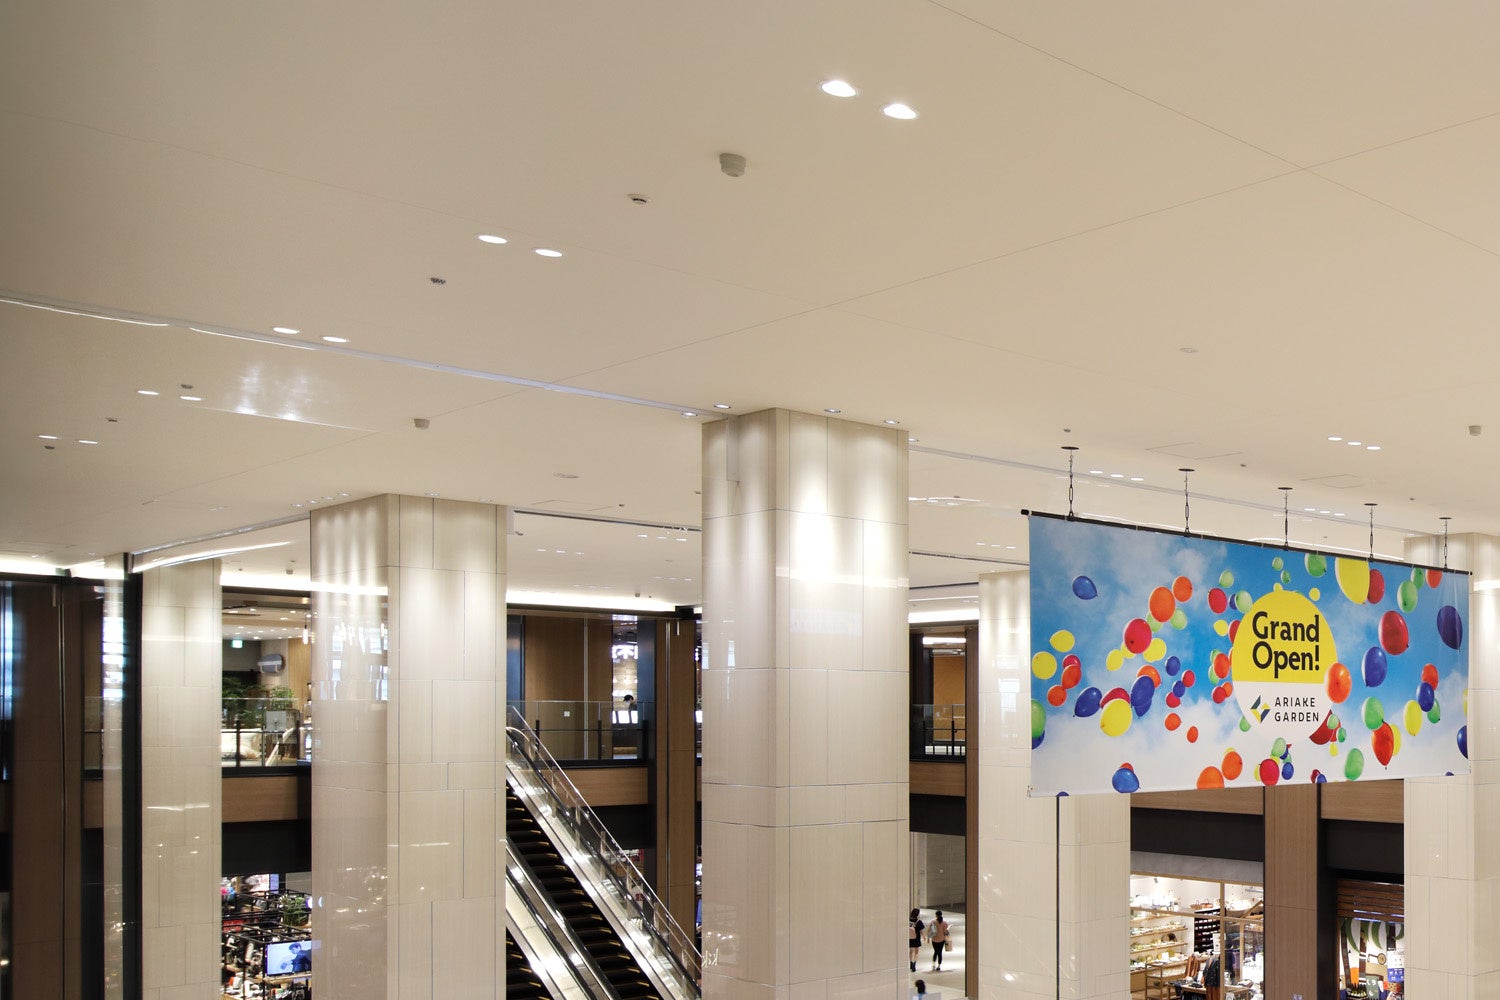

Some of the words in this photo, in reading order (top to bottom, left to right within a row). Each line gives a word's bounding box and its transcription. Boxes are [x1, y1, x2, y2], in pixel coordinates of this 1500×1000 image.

[1252, 610, 1320, 643] Grand
[1252, 640, 1320, 679] Open!
[1274, 697, 1316, 708] ARIAKE
[1274, 712, 1319, 722] GARDEN
